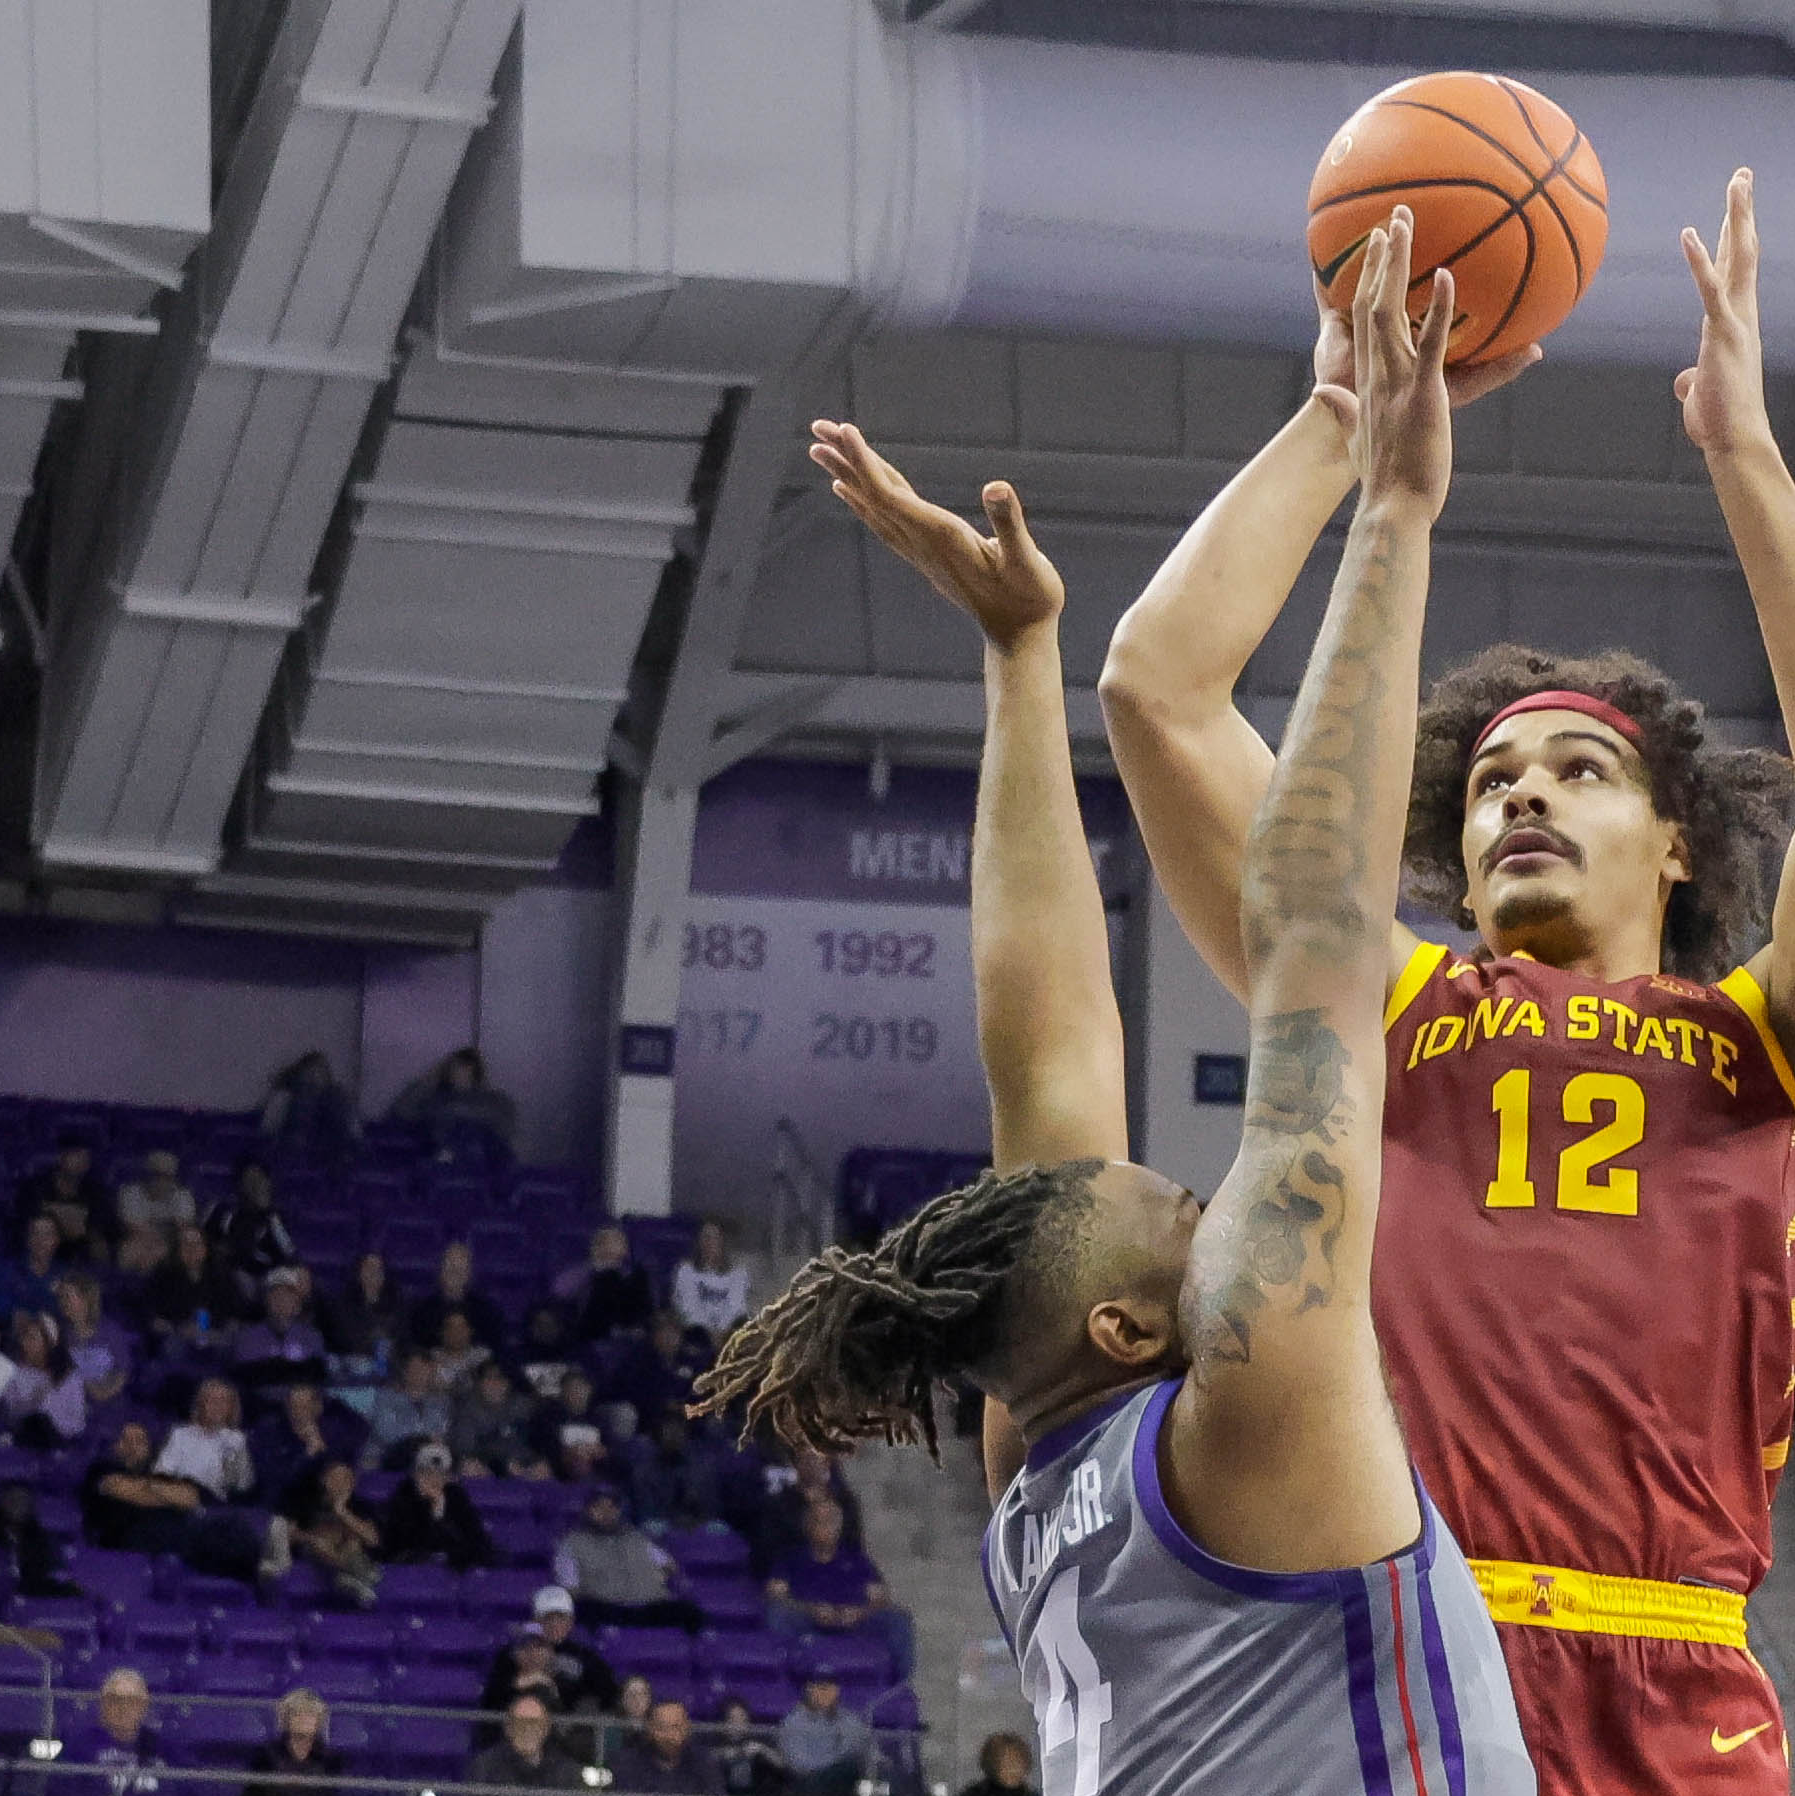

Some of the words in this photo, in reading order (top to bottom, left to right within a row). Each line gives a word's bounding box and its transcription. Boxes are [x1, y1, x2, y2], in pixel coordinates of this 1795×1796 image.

[681, 922, 768, 973] 83
[813, 929, 938, 979] 1992
[809, 1012, 939, 1063] 2019
[1406, 996, 1545, 1072] IOWA
[1566, 994, 1740, 1098] STATE
[1485, 1068, 1645, 1216] 12
